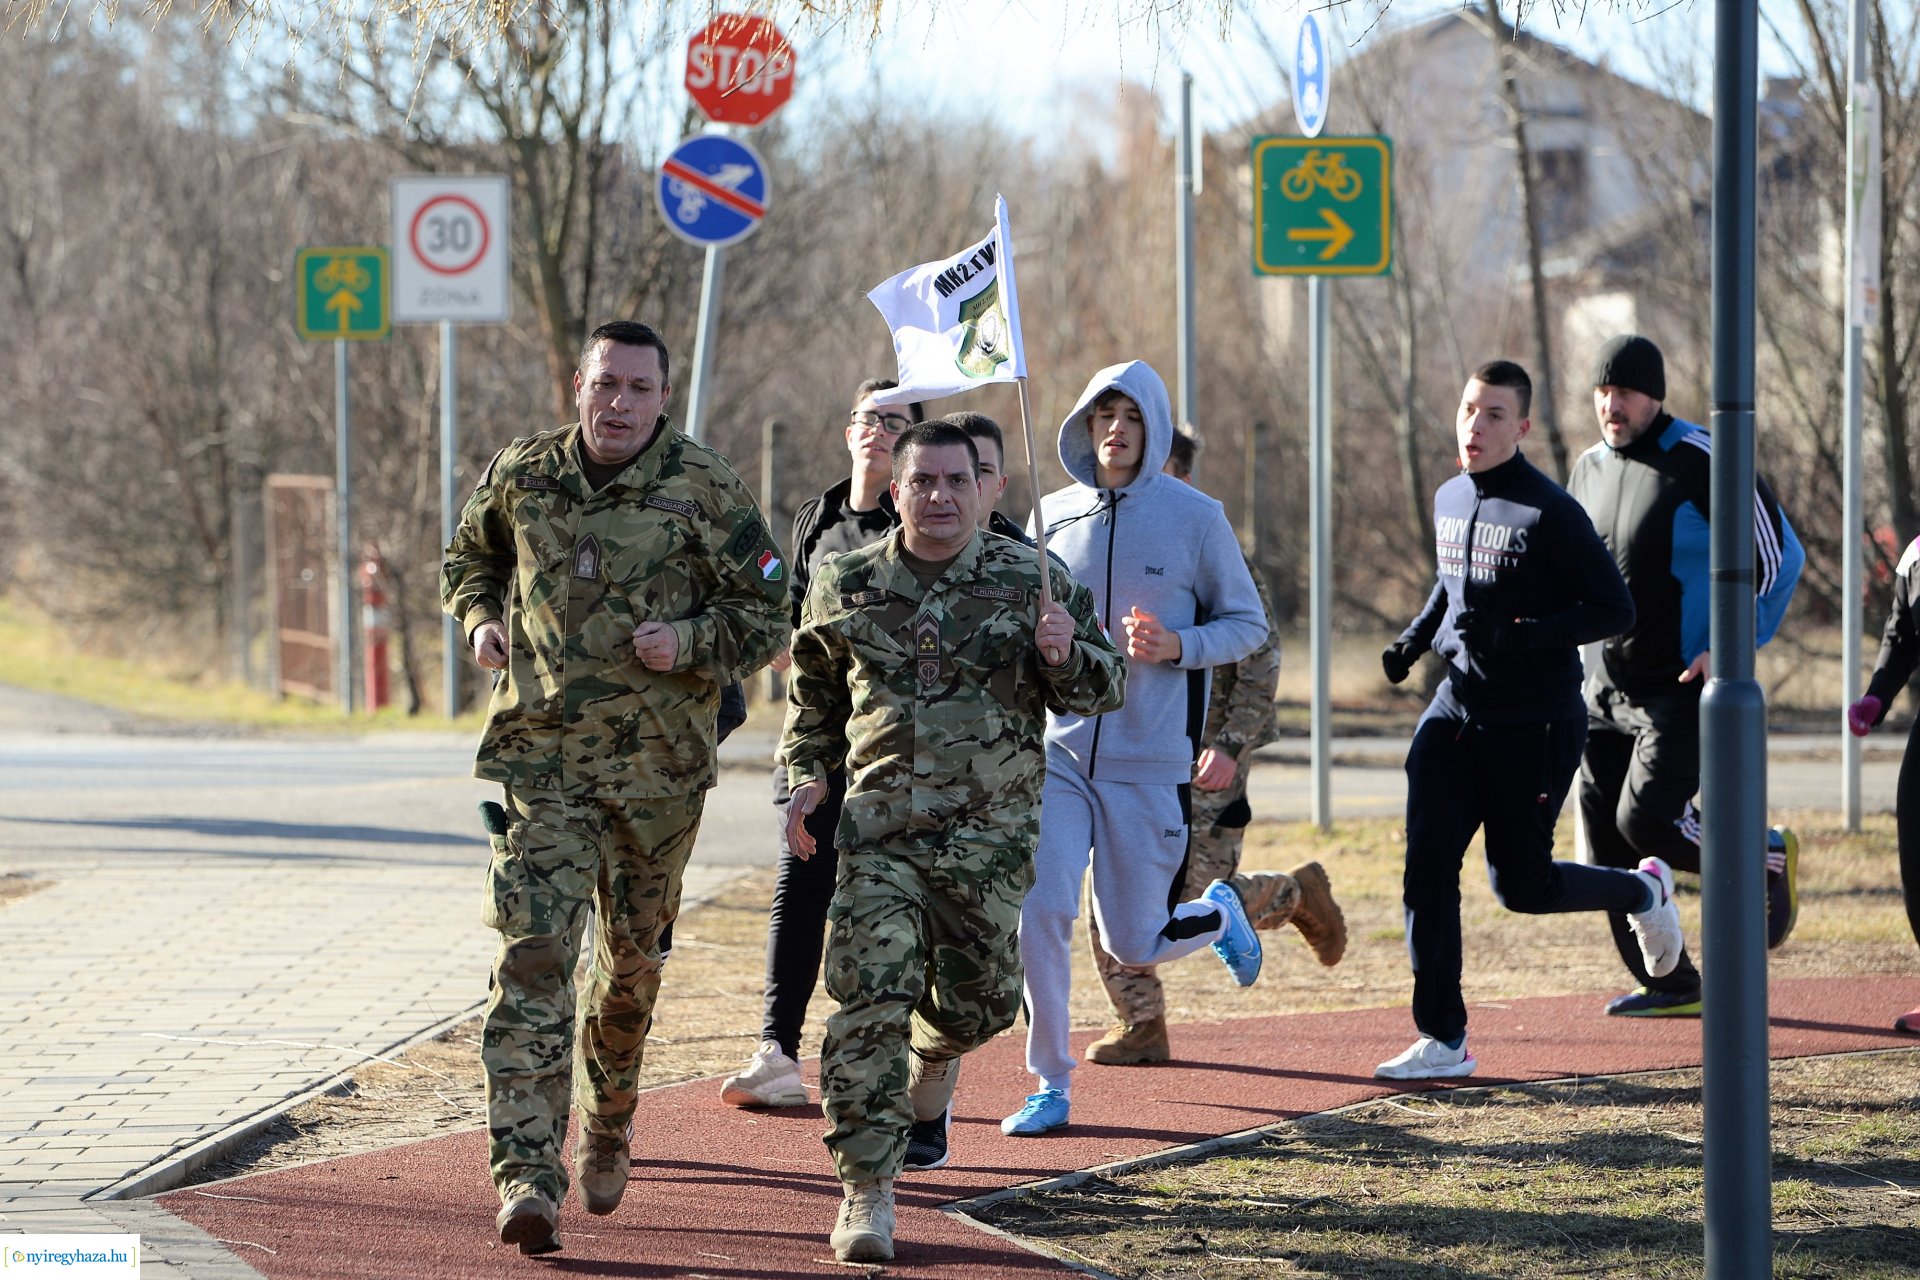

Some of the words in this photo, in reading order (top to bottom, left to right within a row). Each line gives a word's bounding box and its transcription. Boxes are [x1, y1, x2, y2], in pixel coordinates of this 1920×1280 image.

[686, 43, 792, 96] STOP
[427, 216, 472, 254] 30
[653, 499, 687, 511] HUNGARY
[1437, 516, 1469, 543] EAVY
[1474, 521, 1529, 553] TOOLS
[1471, 551, 1518, 567] QUALITY
[1471, 566, 1496, 582] 1971
[980, 589, 1015, 598] HUNGARY
